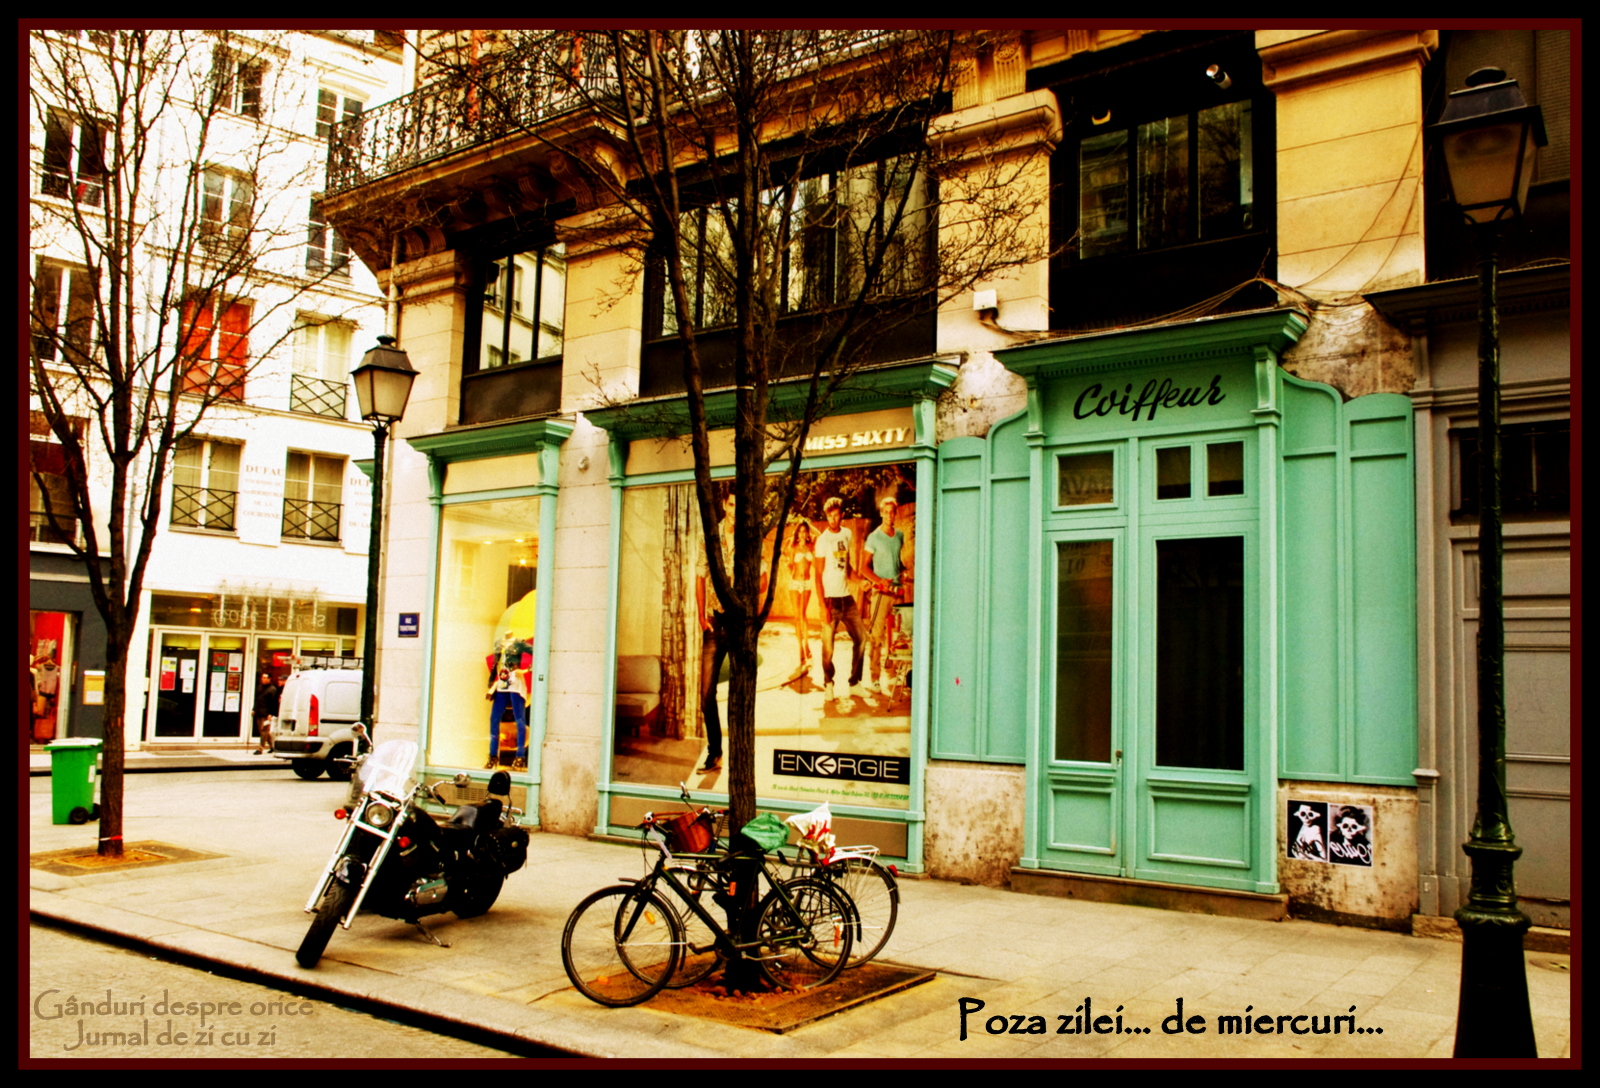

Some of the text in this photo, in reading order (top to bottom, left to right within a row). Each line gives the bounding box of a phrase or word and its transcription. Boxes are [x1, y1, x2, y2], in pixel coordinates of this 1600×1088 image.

[1073, 375, 1226, 421] Coiffeur
[804, 427, 909, 451] MISS SIXTY
